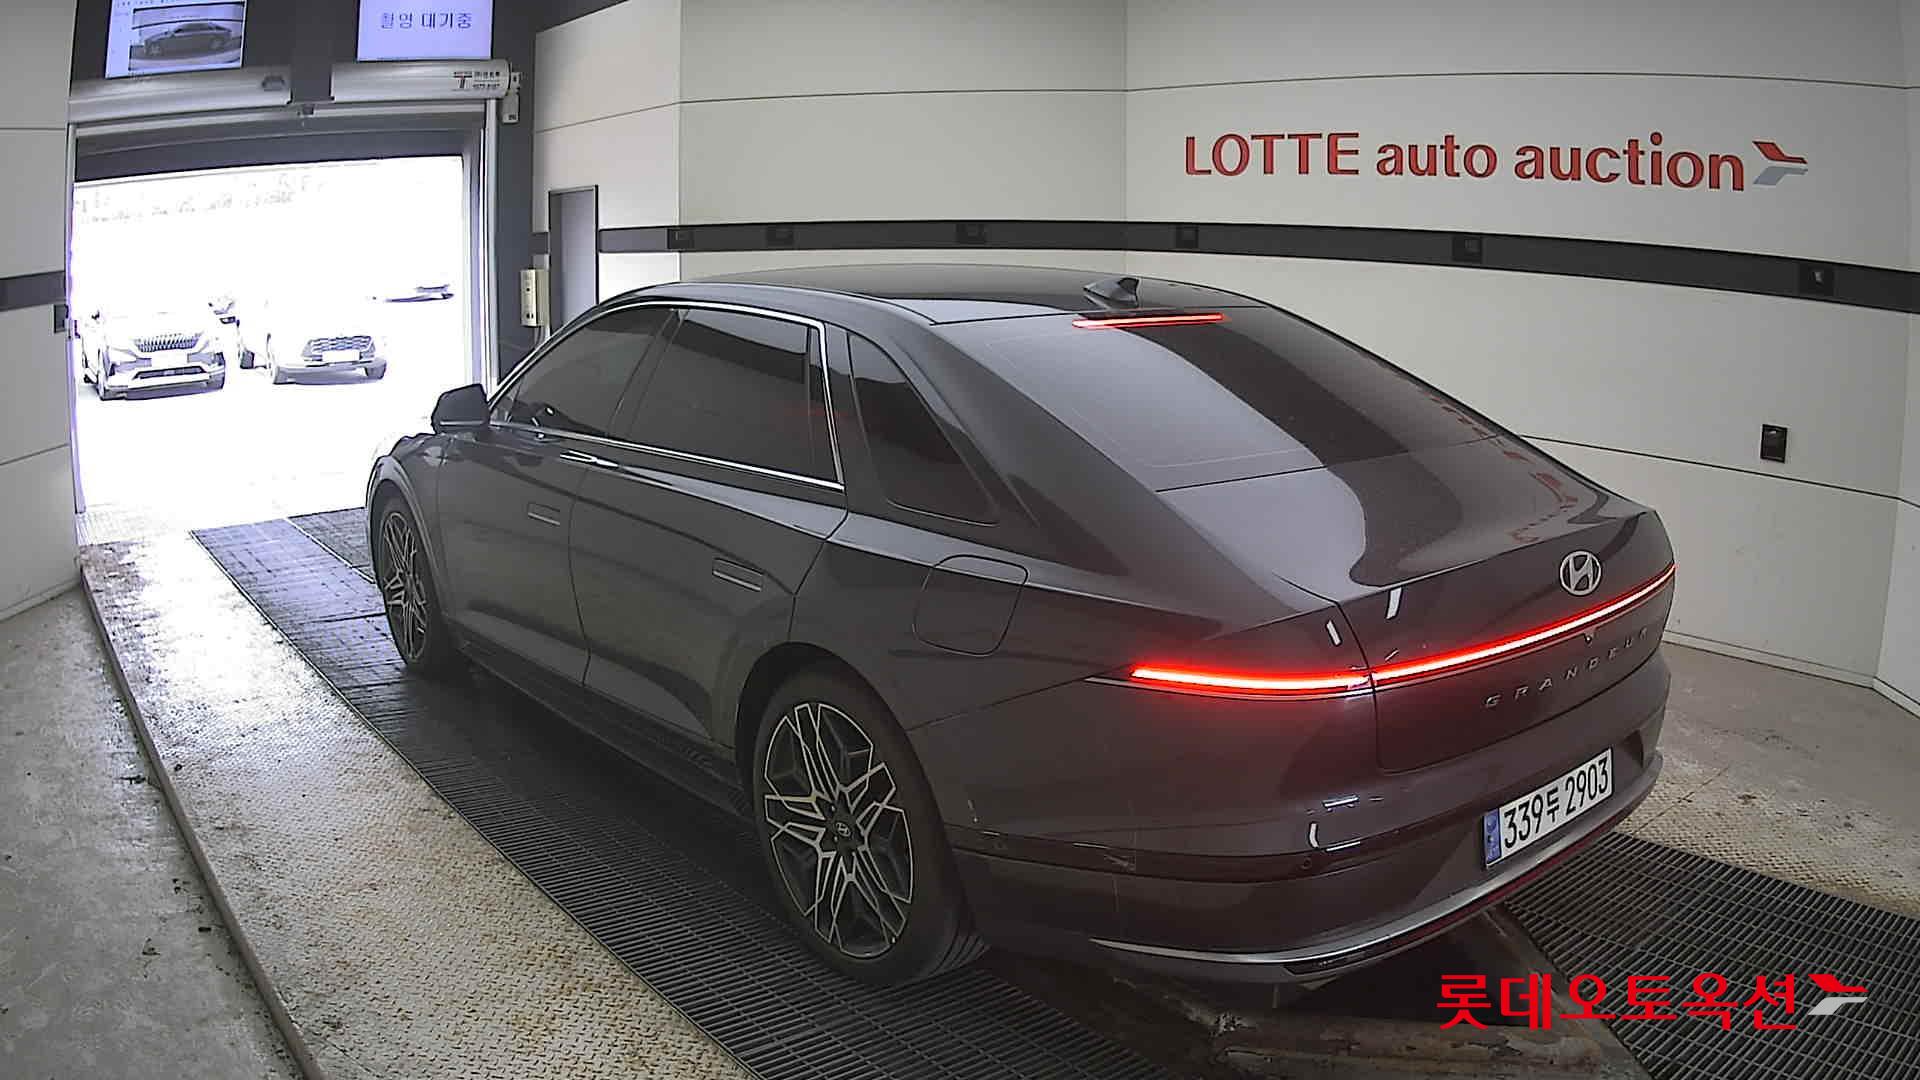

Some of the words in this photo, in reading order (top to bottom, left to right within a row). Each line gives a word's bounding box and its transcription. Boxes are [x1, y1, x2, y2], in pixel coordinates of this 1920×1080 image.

[421, 12, 472, 29] 대기중
[1185, 132, 1360, 176] LOTTE
[1376, 134, 1497, 178] auto
[1513, 131, 1744, 192] auction
[1504, 792, 1561, 850] 339두
[1565, 756, 1609, 814] 2903
